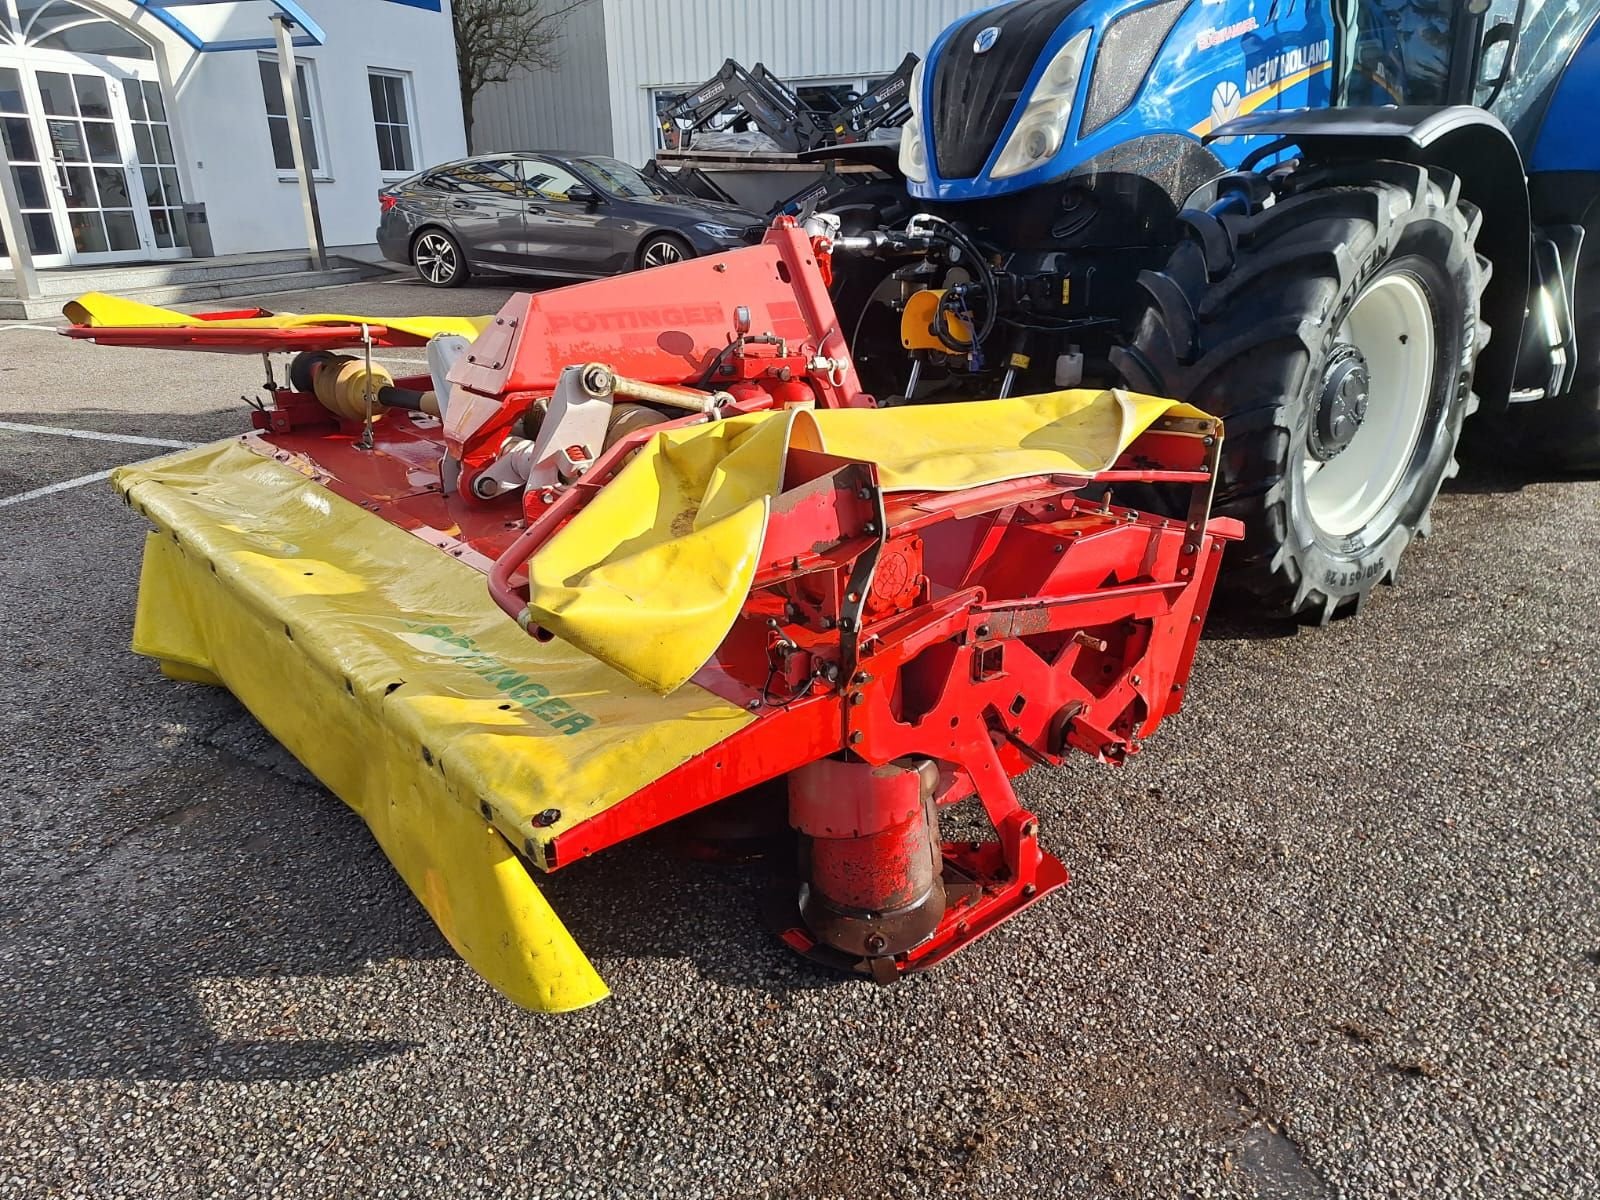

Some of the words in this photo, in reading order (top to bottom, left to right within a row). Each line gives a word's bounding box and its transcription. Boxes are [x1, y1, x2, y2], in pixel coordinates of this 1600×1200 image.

[1245, 56, 1280, 93] NEW
[1280, 39, 1330, 77] HOLLAND
[548, 304, 724, 334] PÖTTINGER
